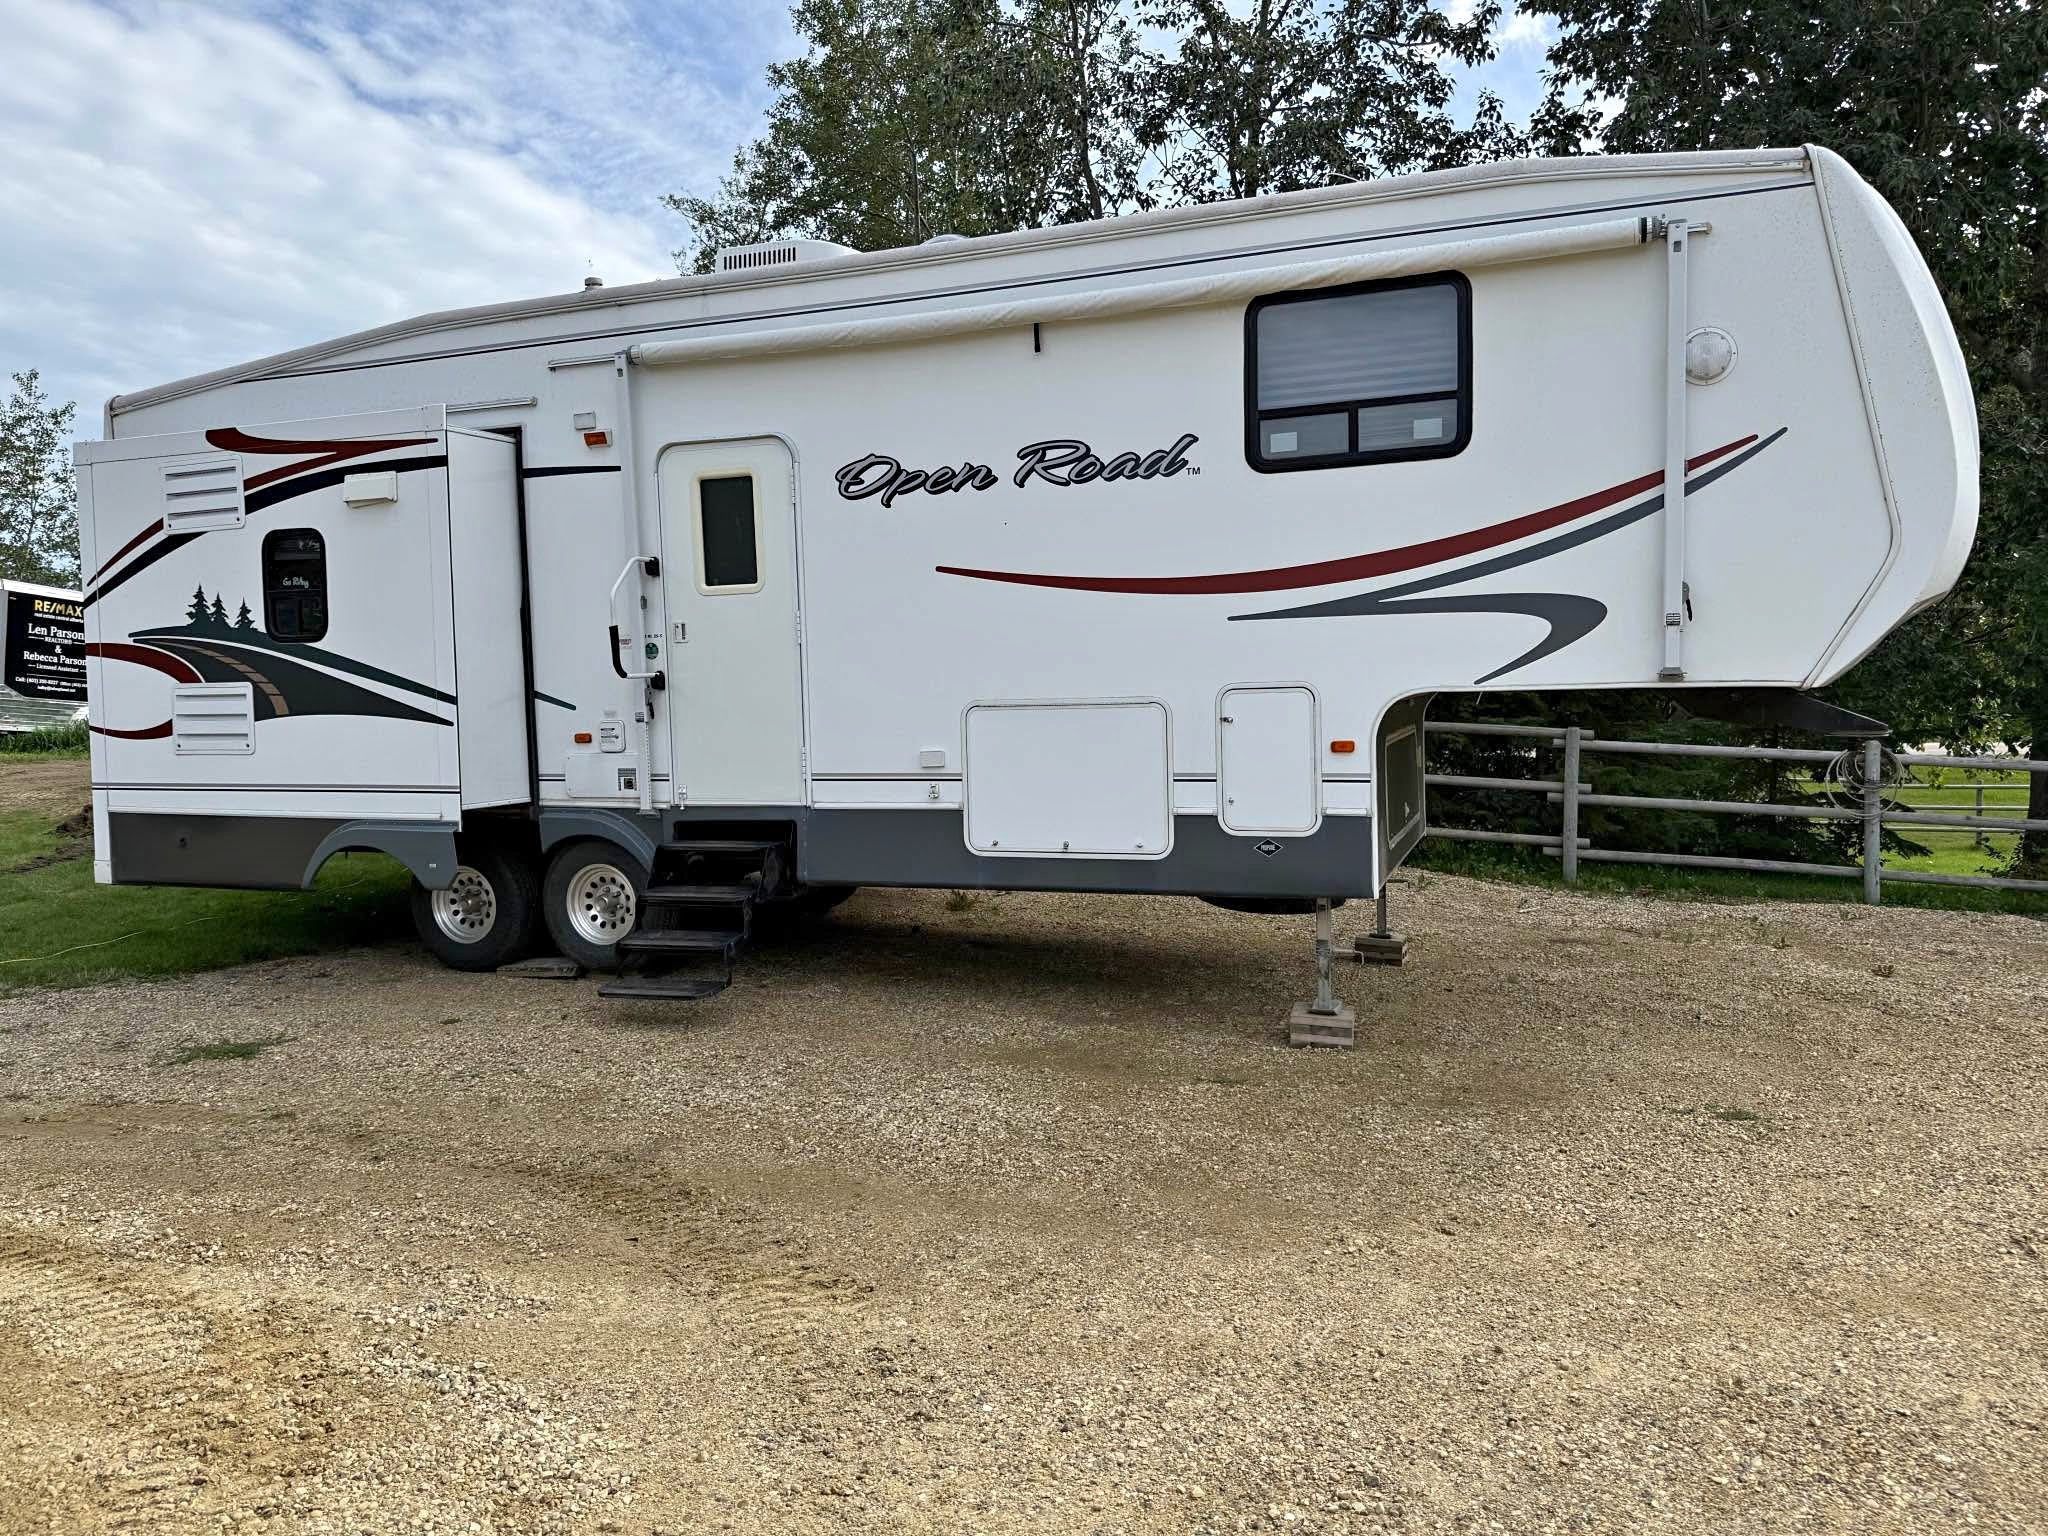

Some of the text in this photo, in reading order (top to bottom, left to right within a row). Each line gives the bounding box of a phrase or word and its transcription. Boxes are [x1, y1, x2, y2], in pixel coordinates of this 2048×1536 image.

[835, 453, 998, 508] Open
[1013, 433, 1199, 488] Road
[34, 600, 83, 617] RE/MAX
[28, 622, 84, 640] Len Parson
[23, 651, 58, 663] Rebecca
[55, 645, 62, 654] &
